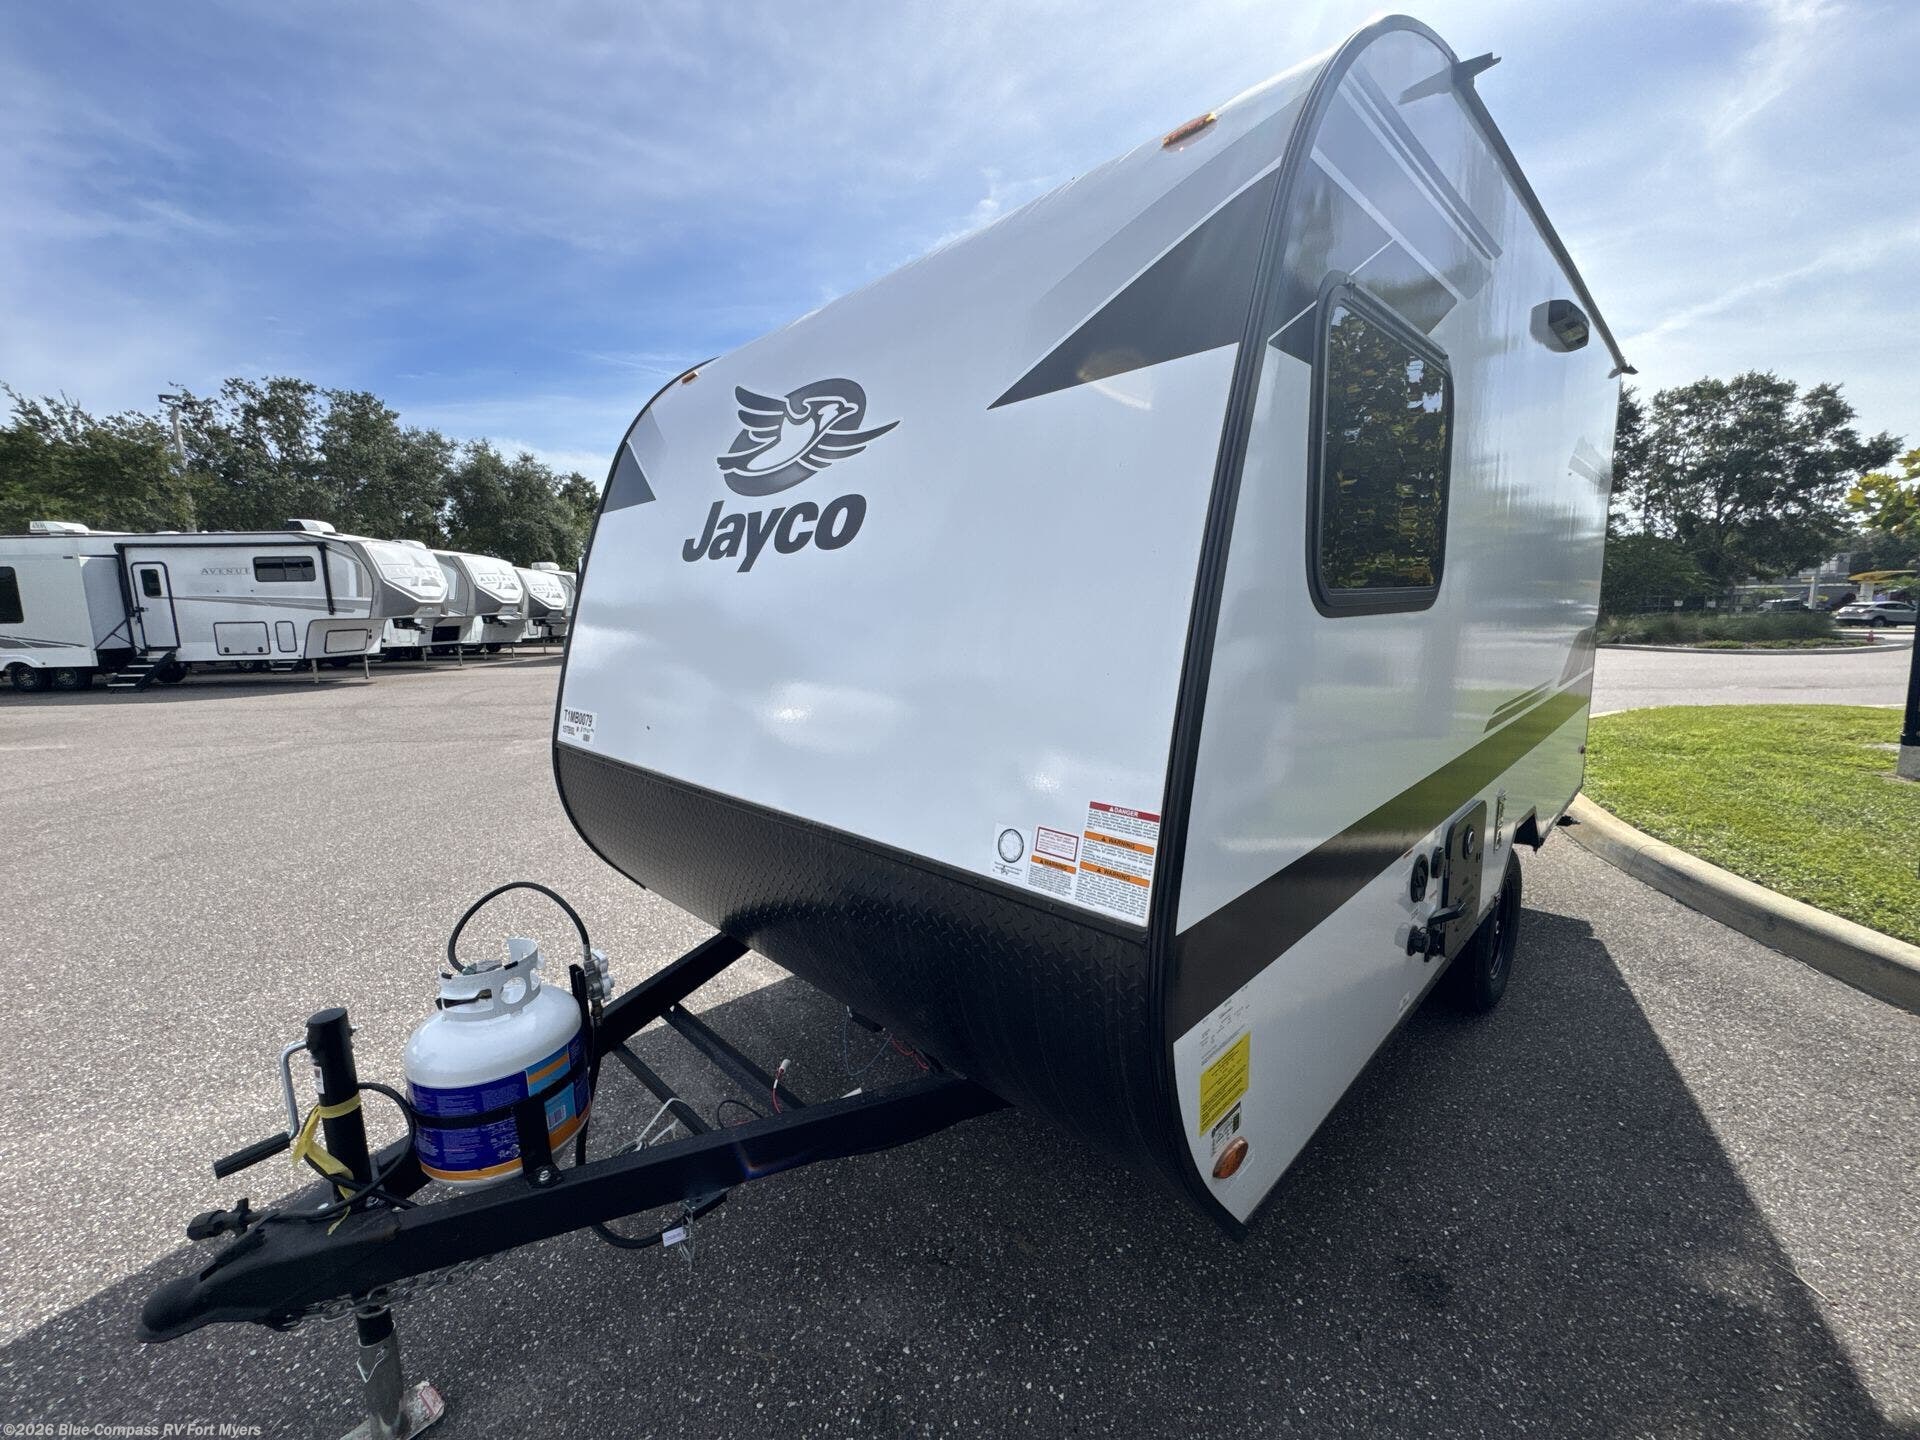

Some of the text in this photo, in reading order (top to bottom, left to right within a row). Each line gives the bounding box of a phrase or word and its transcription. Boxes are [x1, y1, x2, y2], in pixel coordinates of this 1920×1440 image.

[682, 494, 867, 573] Jayco
[1114, 807, 1139, 818] DANGER
[1108, 837, 1136, 849] WARNING
[1043, 859, 1068, 871] WARNING
[1103, 867, 1131, 881] WARNING
